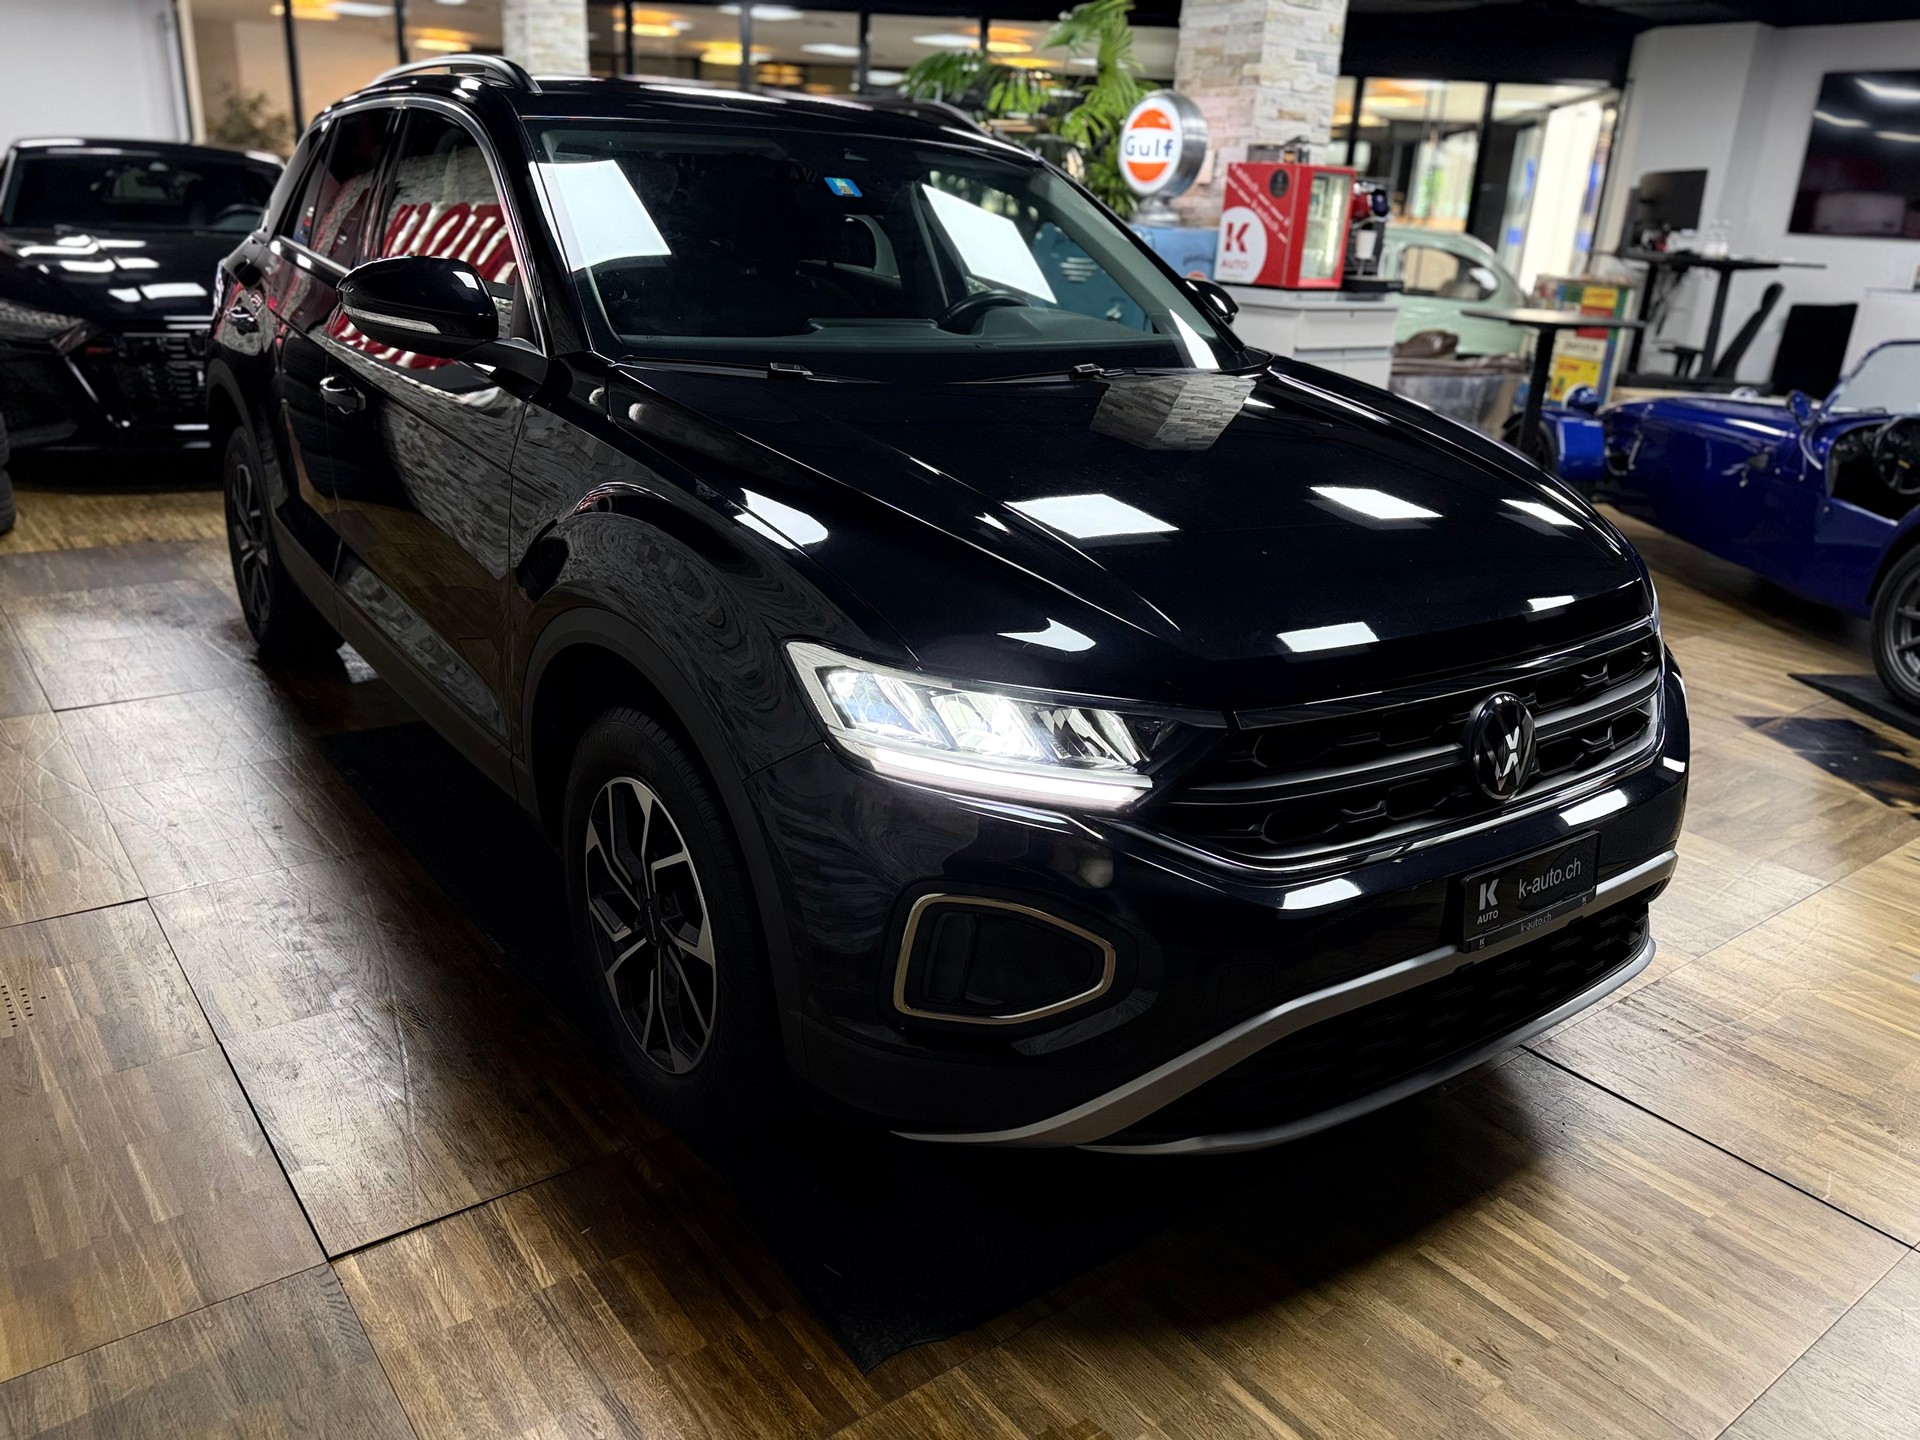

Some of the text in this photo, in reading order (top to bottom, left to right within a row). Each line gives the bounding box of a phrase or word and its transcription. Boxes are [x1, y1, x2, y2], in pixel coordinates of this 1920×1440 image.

[1125, 135, 1173, 157] Gulf
[1225, 223, 1249, 253] K
[1221, 260, 1248, 270] AUTO
[1479, 858, 1581, 911] K k-auto.ch
[1477, 909, 1499, 925] AUTO
[1520, 912, 1552, 933] k-auto.ch
